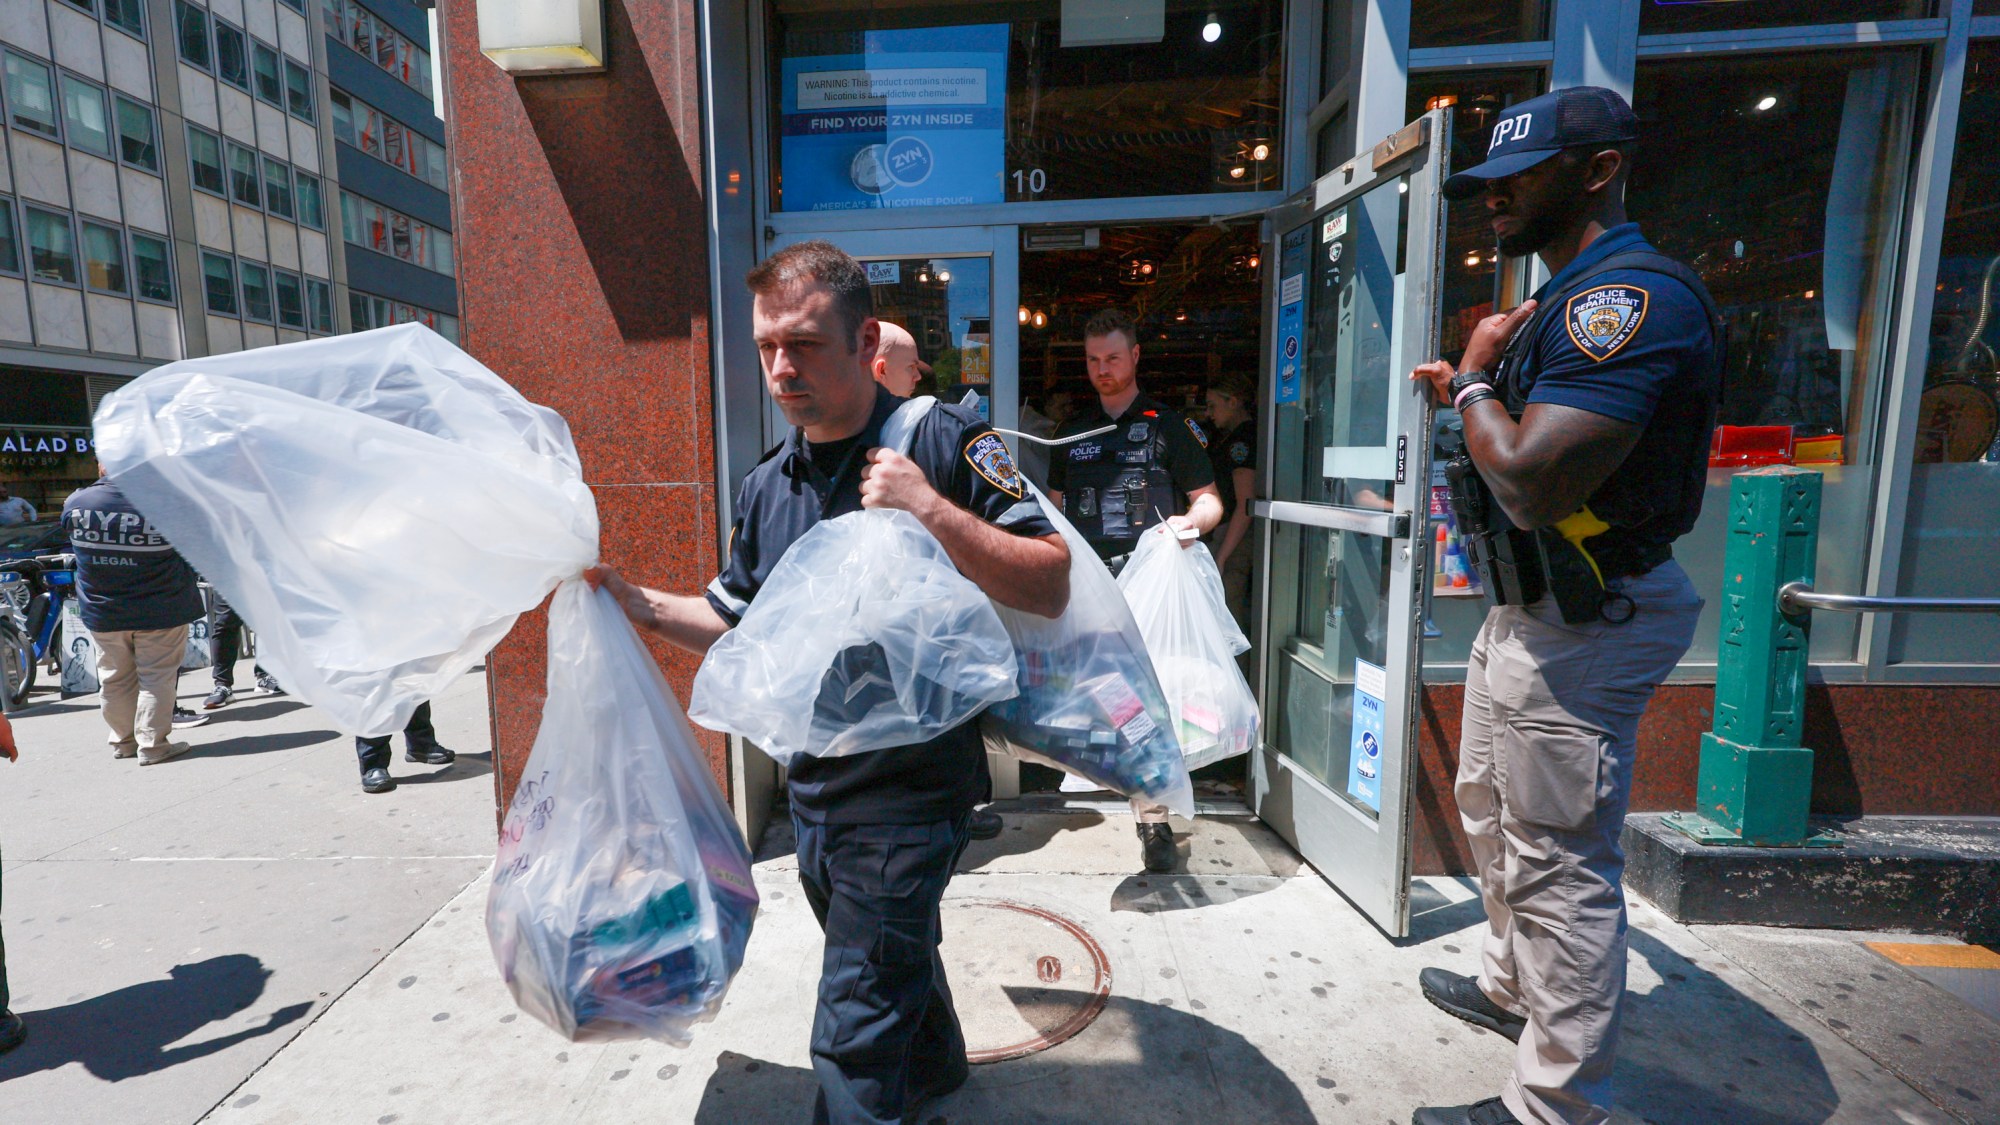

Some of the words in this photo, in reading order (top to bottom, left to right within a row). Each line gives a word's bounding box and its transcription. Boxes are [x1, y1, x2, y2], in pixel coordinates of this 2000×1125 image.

[805, 79, 850, 90] WARNING:
[851, 78, 869, 88] This
[871, 77, 902, 88] product
[903, 76, 940, 86] contains
[942, 75, 979, 86] nicotine.
[824, 92, 858, 100] Nicotine
[860, 90, 866, 98] is
[880, 88, 916, 98] addictive
[918, 88, 960, 98] chemical.
[811, 117, 845, 129] FIND
[848, 116, 888, 127] YOUR
[892, 114, 922, 126] ZYN
[925, 114, 974, 124] INSIDE
[892, 146, 922, 168] ZYN
[1012, 168, 1046, 194] 10
[812, 201, 867, 212] AMERICA'S
[884, 197, 936, 208] NICOTINE
[936, 196, 974, 206] POUCH
[1326, 217, 1342, 232] RAW
[870, 267, 892, 279] RAW
[1588, 290, 1626, 301] POLICE
[1573, 297, 1640, 314] DEPARTMENT
[1571, 322, 1584, 338] CITY
[1581, 338, 1593, 348] OF
[1607, 333, 1626, 350] NEW
[1623, 311, 1641, 334] YORK
[964, 356, 988, 371] 21+
[966, 373, 985, 383] PUSH
[975, 435, 996, 450] POLICE
[973, 441, 1004, 464] DEPARTM
[1069, 446, 1102, 457] POLICE
[73, 528, 162, 545] POLICE
[92, 555, 138, 566] LEGAL
[1362, 696, 1378, 712] ZYN
